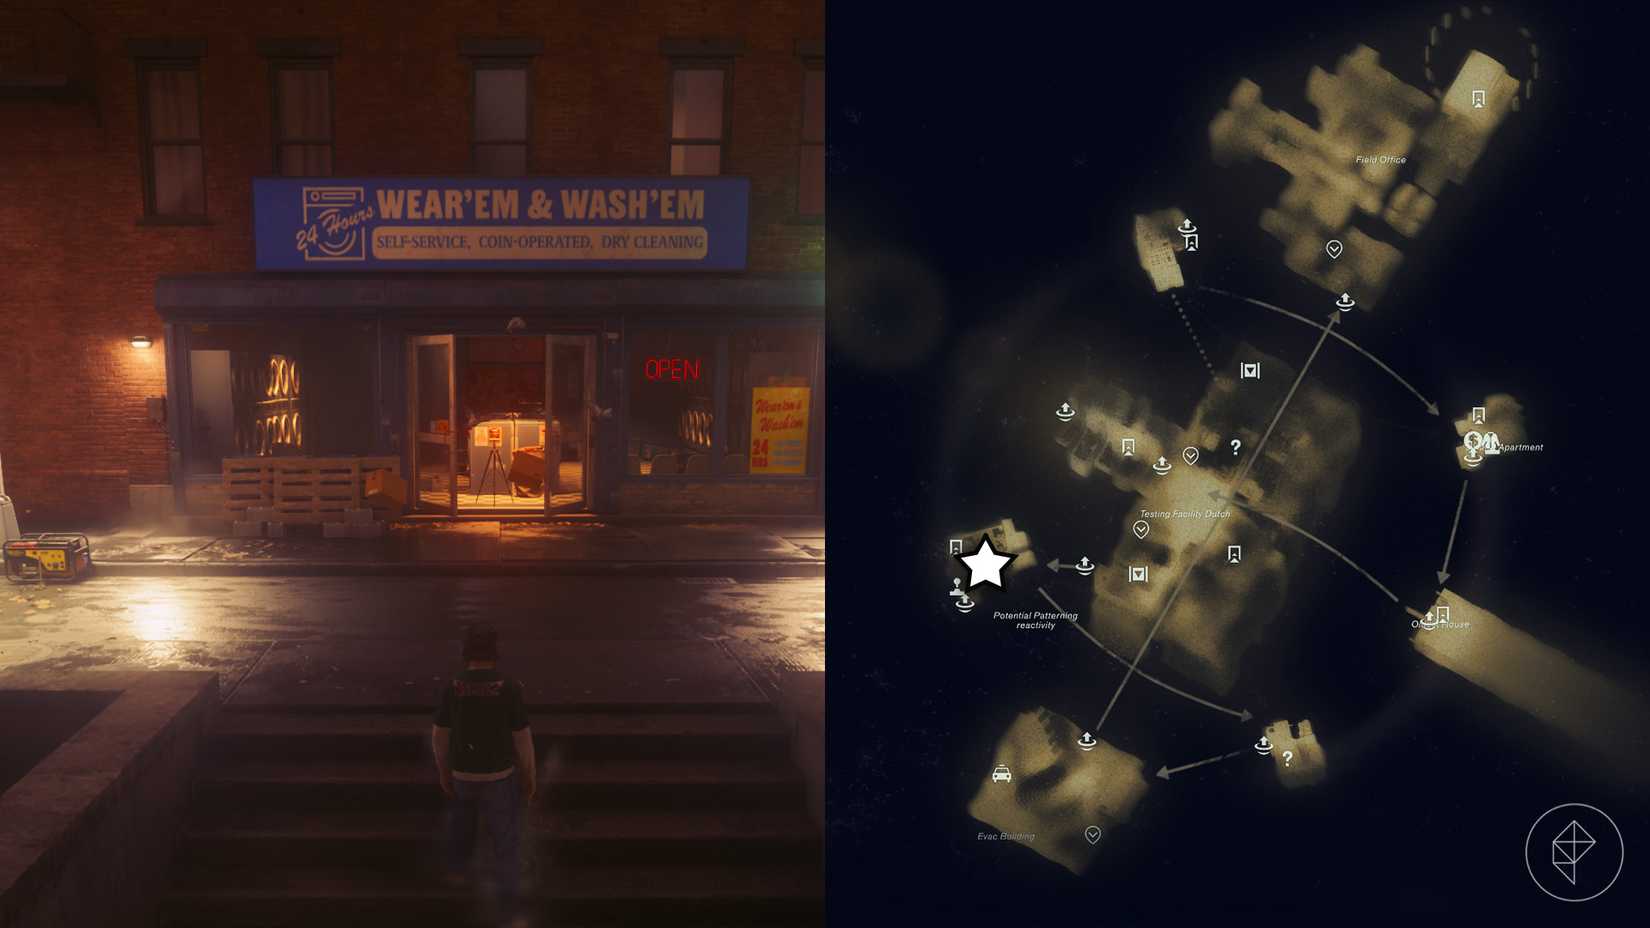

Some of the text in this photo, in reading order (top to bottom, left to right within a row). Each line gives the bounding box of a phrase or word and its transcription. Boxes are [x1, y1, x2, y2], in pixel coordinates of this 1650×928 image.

[376, 189, 705, 220] WEAR'EM & WASH'EM
[296, 205, 375, 252] 24 Hours
[376, 234, 704, 251] SELF-SERVICE, COIN-OPERATED, DRY CLEANING
[645, 358, 700, 381] OPEN
[752, 438, 769, 456] 24
